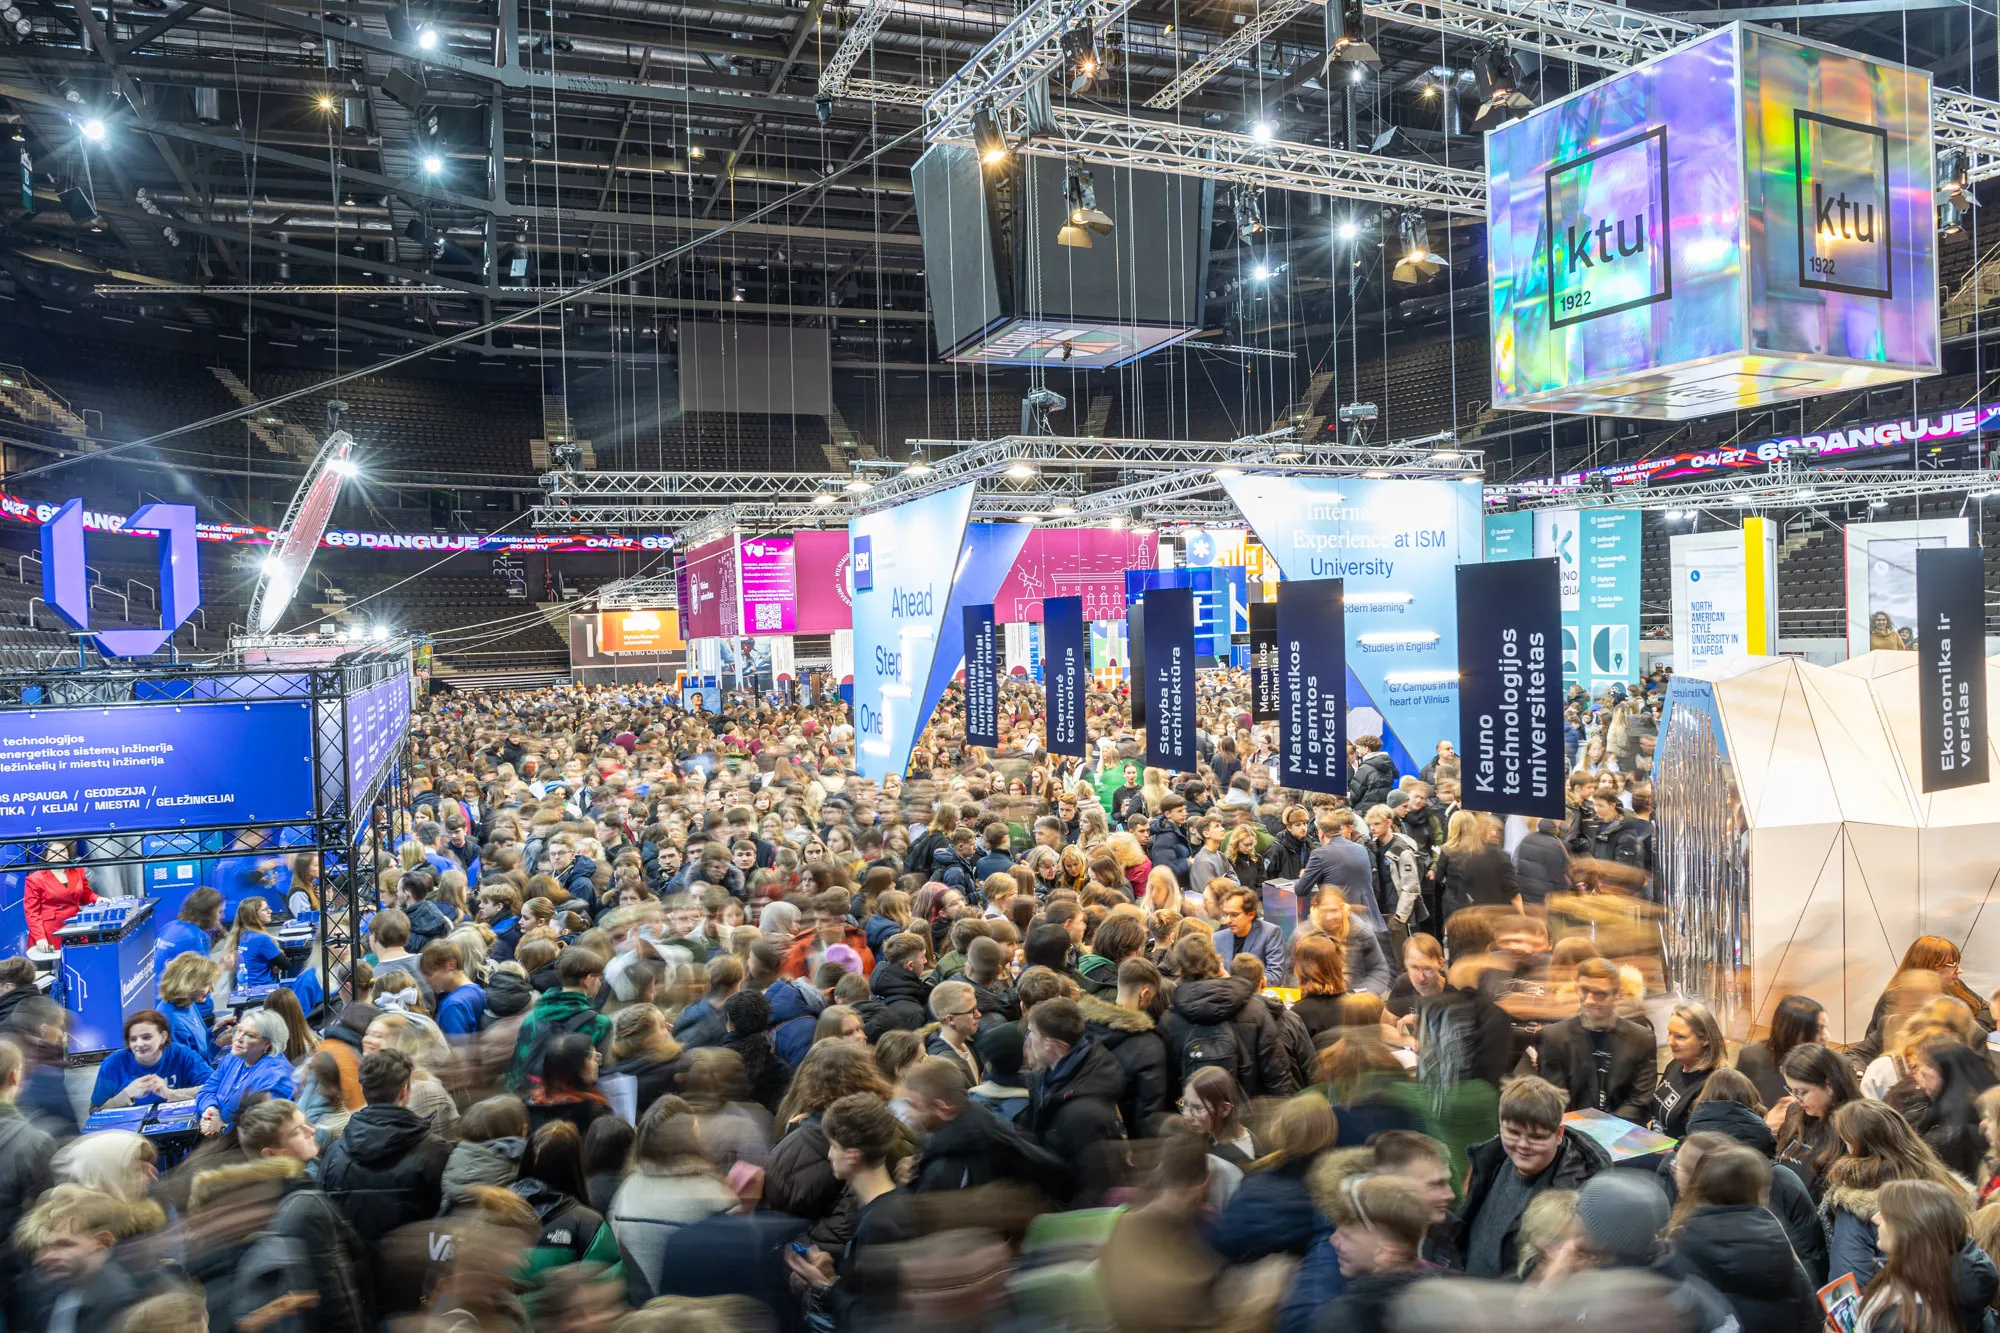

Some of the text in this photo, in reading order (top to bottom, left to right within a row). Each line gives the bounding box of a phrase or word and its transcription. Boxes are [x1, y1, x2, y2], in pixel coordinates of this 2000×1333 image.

[1815, 183, 1874, 243] ktu
[1568, 213, 1644, 274] ktu
[1809, 256, 1835, 275] 1922
[1560, 291, 1591, 312] 1922
[1802, 411, 1977, 453] DANGUJE
[1690, 448, 1747, 468] 04/27
[2, 498, 28, 516] 04/27
[326, 532, 479, 549] 69 DANGUJE
[586, 537, 633, 548] 04/27
[641, 537, 674, 548] 69
[1394, 532, 1409, 548] at
[1416, 530, 1446, 548] ISM
[1310, 558, 1394, 578] University
[892, 583, 933, 618] Ahead
[1344, 603, 1405, 613] odern learning
[1691, 601, 1712, 611] NORTH
[1691, 611, 1725, 622] AMERICAN
[1691, 623, 1711, 633] STYLE
[1270, 645, 1279, 654] ir
[1362, 641, 1436, 653] Studies in English
[1692, 634, 1738, 644] UNIVERSITY IN
[875, 645, 902, 683] Step
[975, 634, 985, 735] humanitariniai
[983, 621, 994, 736] mokslai ir menai
[1258, 642, 1269, 712] Mechanikos
[1403, 682, 1437, 693] Campus
[1438, 682, 1446, 690] in
[1448, 681, 1460, 689] the
[969, 660, 977, 734] Socialiniai,
[1065, 647, 1076, 743] technologija
[1171, 647, 1182, 757] architektūra
[1389, 695, 1450, 707] heart of Vilnius
[1938, 613, 1954, 771] Ekonomika ir
[1056, 674, 1064, 742] Cheminė
[1159, 668, 1171, 755] Statyba ir
[1288, 640, 1302, 773] Matematikos
[1499, 628, 1523, 795] technologijos
[1526, 632, 1547, 797] universitetas
[860, 703, 883, 735] One
[1306, 676, 1321, 775] ir gamtos
[1956, 681, 1971, 768] verslas
[3, 734, 85, 747] technologijos
[1322, 694, 1336, 777] mokslai
[0, 742, 174, 761] energetikos sistemų inžinerija
[1476, 714, 1494, 793] Kauno
[0, 755, 165, 772] ležinkelių ir miestų inžinerija
[0, 806, 25, 816] TIKA
[42, 802, 78, 814] KELIAI
[95, 799, 140, 811] MIESTAI
[156, 793, 235, 807] GELEŽINKELIAI
[13, 790, 68, 802] APSAUGA
[85, 786, 146, 798] GEODEZIJA
